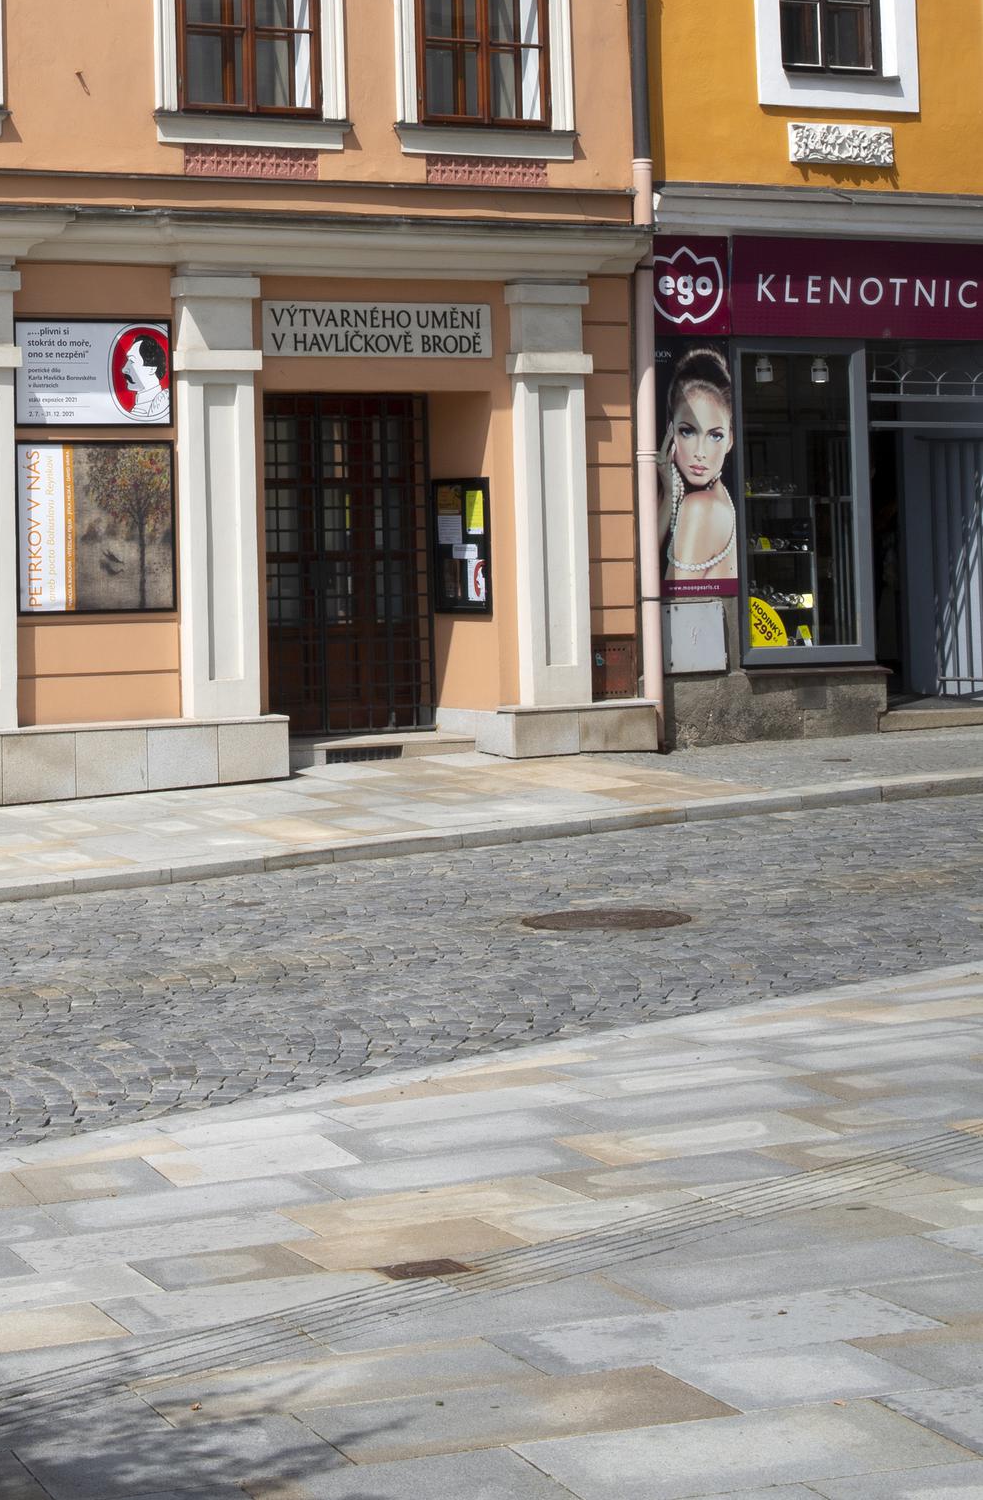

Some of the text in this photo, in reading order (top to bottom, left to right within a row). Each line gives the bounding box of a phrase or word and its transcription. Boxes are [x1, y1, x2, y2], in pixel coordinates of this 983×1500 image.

[658, 274, 714, 305] ego
[756, 273, 979, 308] KLENOTNIC
[270, 305, 482, 329] VÝTVARNÉHO UMĚNÍ
[63, 326, 69, 335] si
[271, 330, 483, 354] V HAVLÍČKOVĚ BRODĚ
[27, 338, 92, 348] stokrát do moře,
[23, 450, 43, 607] PETRKOV V NÁS
[752, 601, 783, 637] HODINKY
[753, 618, 773, 641] 299
